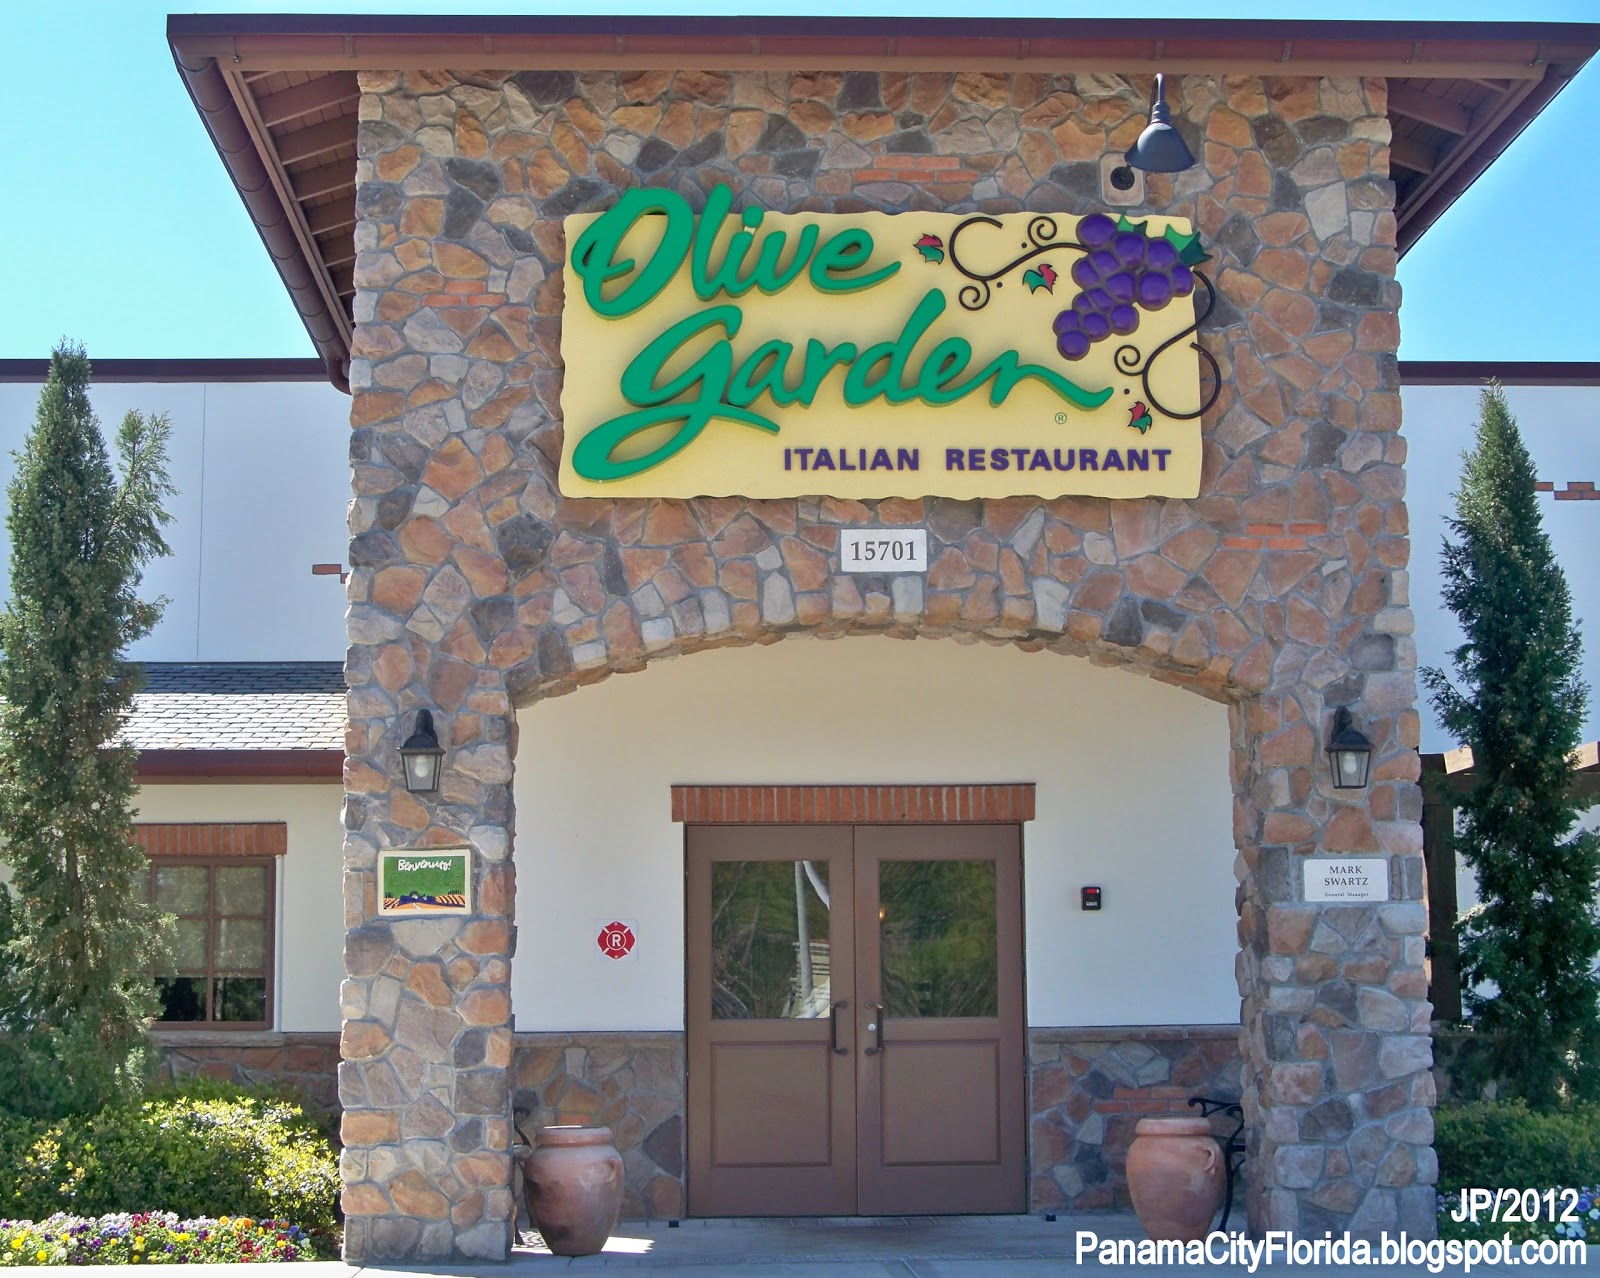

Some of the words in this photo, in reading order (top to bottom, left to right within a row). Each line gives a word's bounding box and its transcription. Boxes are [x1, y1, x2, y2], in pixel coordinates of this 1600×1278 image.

[571, 183, 903, 320] Olive
[783, 447, 920, 471] ITALIAN
[945, 447, 1173, 471] RESTAURANT
[850, 540, 918, 562] 15701
[1329, 865, 1363, 875] MARK
[1324, 877, 1369, 887] SWARTZ
[1346, 891, 1369, 899] Manager
[612, 933, 622, 947] R
